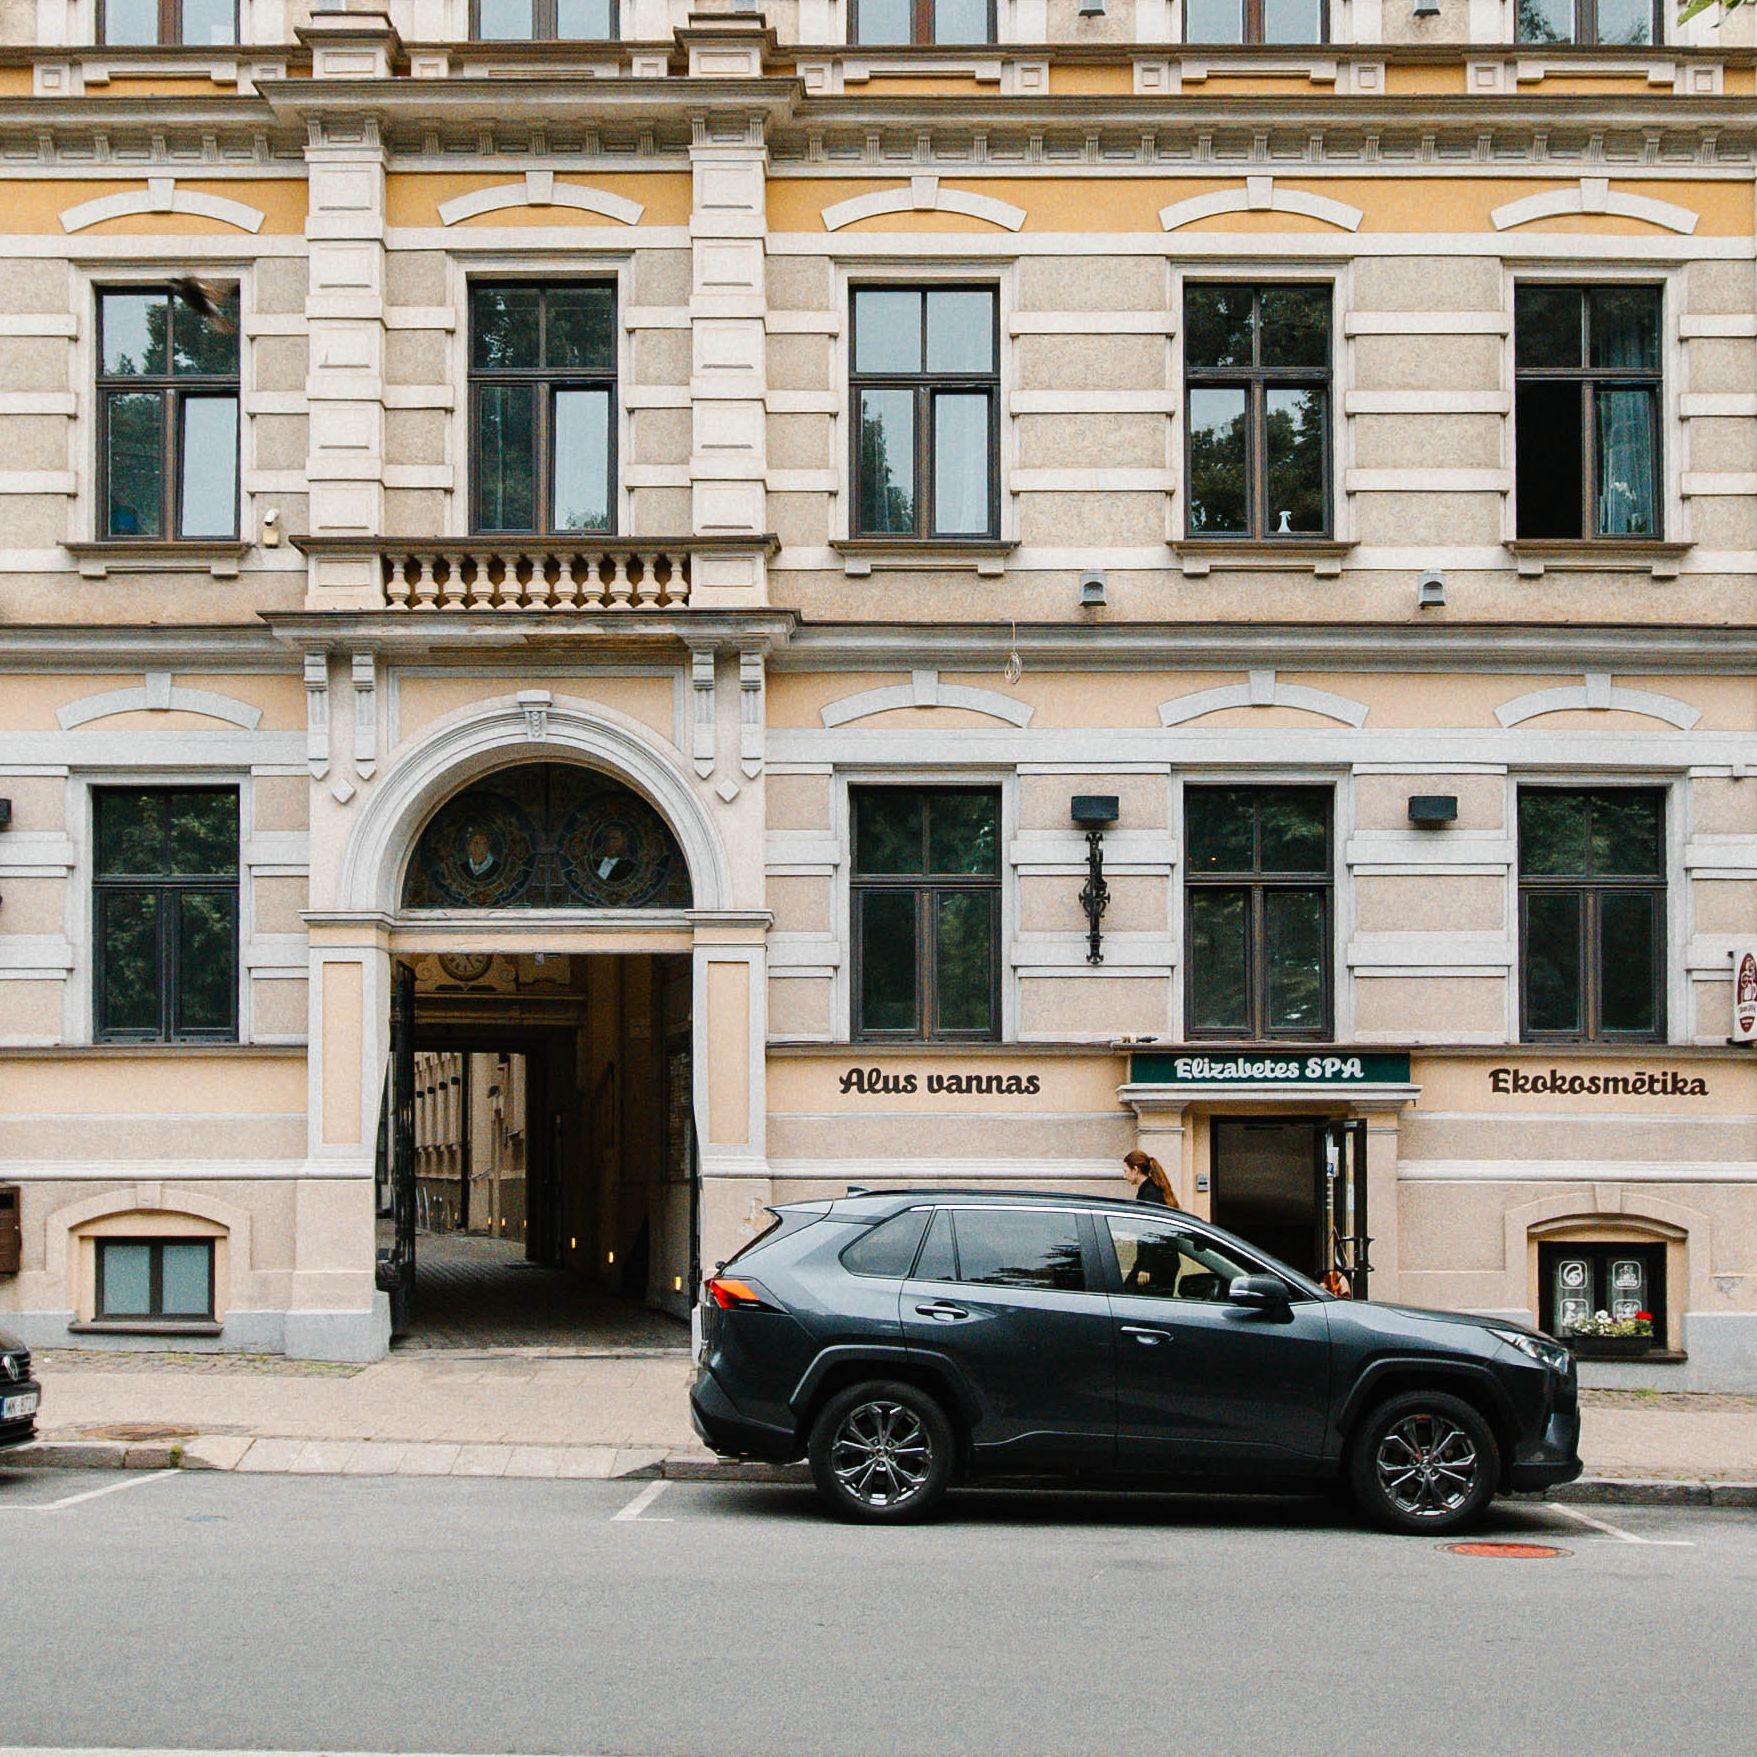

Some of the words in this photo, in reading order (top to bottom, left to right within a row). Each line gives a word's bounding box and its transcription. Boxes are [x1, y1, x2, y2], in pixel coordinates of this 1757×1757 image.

[839, 1067, 918, 1094] Alus
[927, 1074, 1041, 1094] vannas
[1174, 1057, 1300, 1080] Elizabetes
[1304, 1057, 1365, 1079] SPA
[1488, 1068, 1710, 1096] Ekokosmētika
